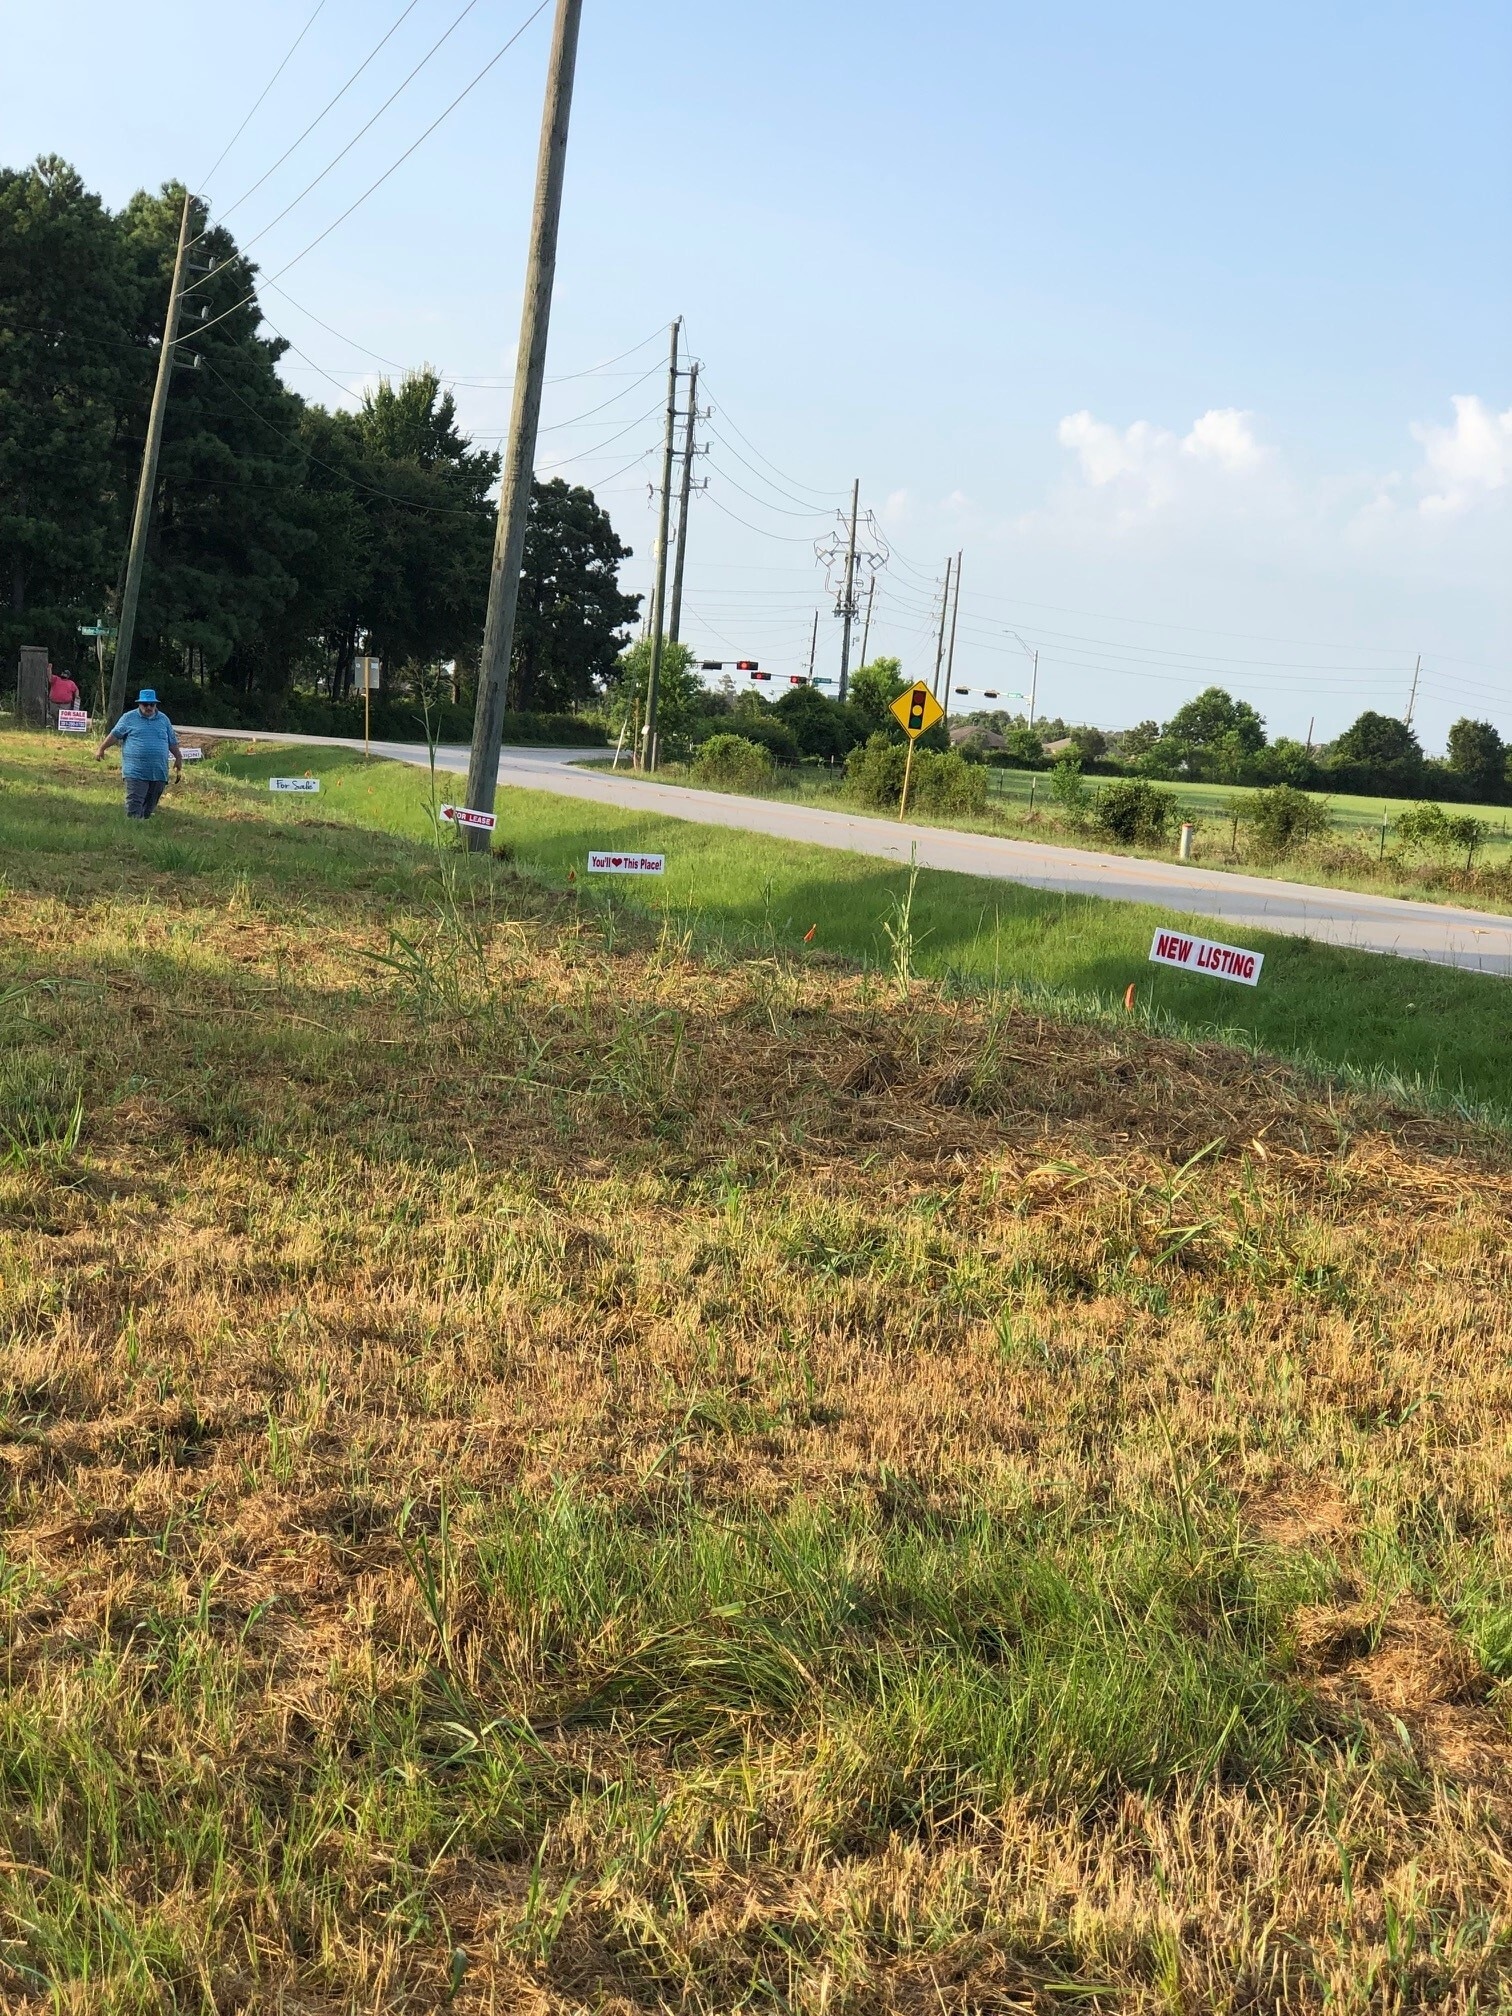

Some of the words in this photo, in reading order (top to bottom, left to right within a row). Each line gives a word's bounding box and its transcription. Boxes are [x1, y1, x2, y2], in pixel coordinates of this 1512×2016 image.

[276, 780, 289, 788] For
[470, 814, 490, 825] LEASE
[592, 856, 611, 868] You'll
[624, 858, 638, 869] This
[641, 858, 662, 870] Place!
[1156, 934, 1193, 962] NEW
[1197, 945, 1255, 978] LISTING
